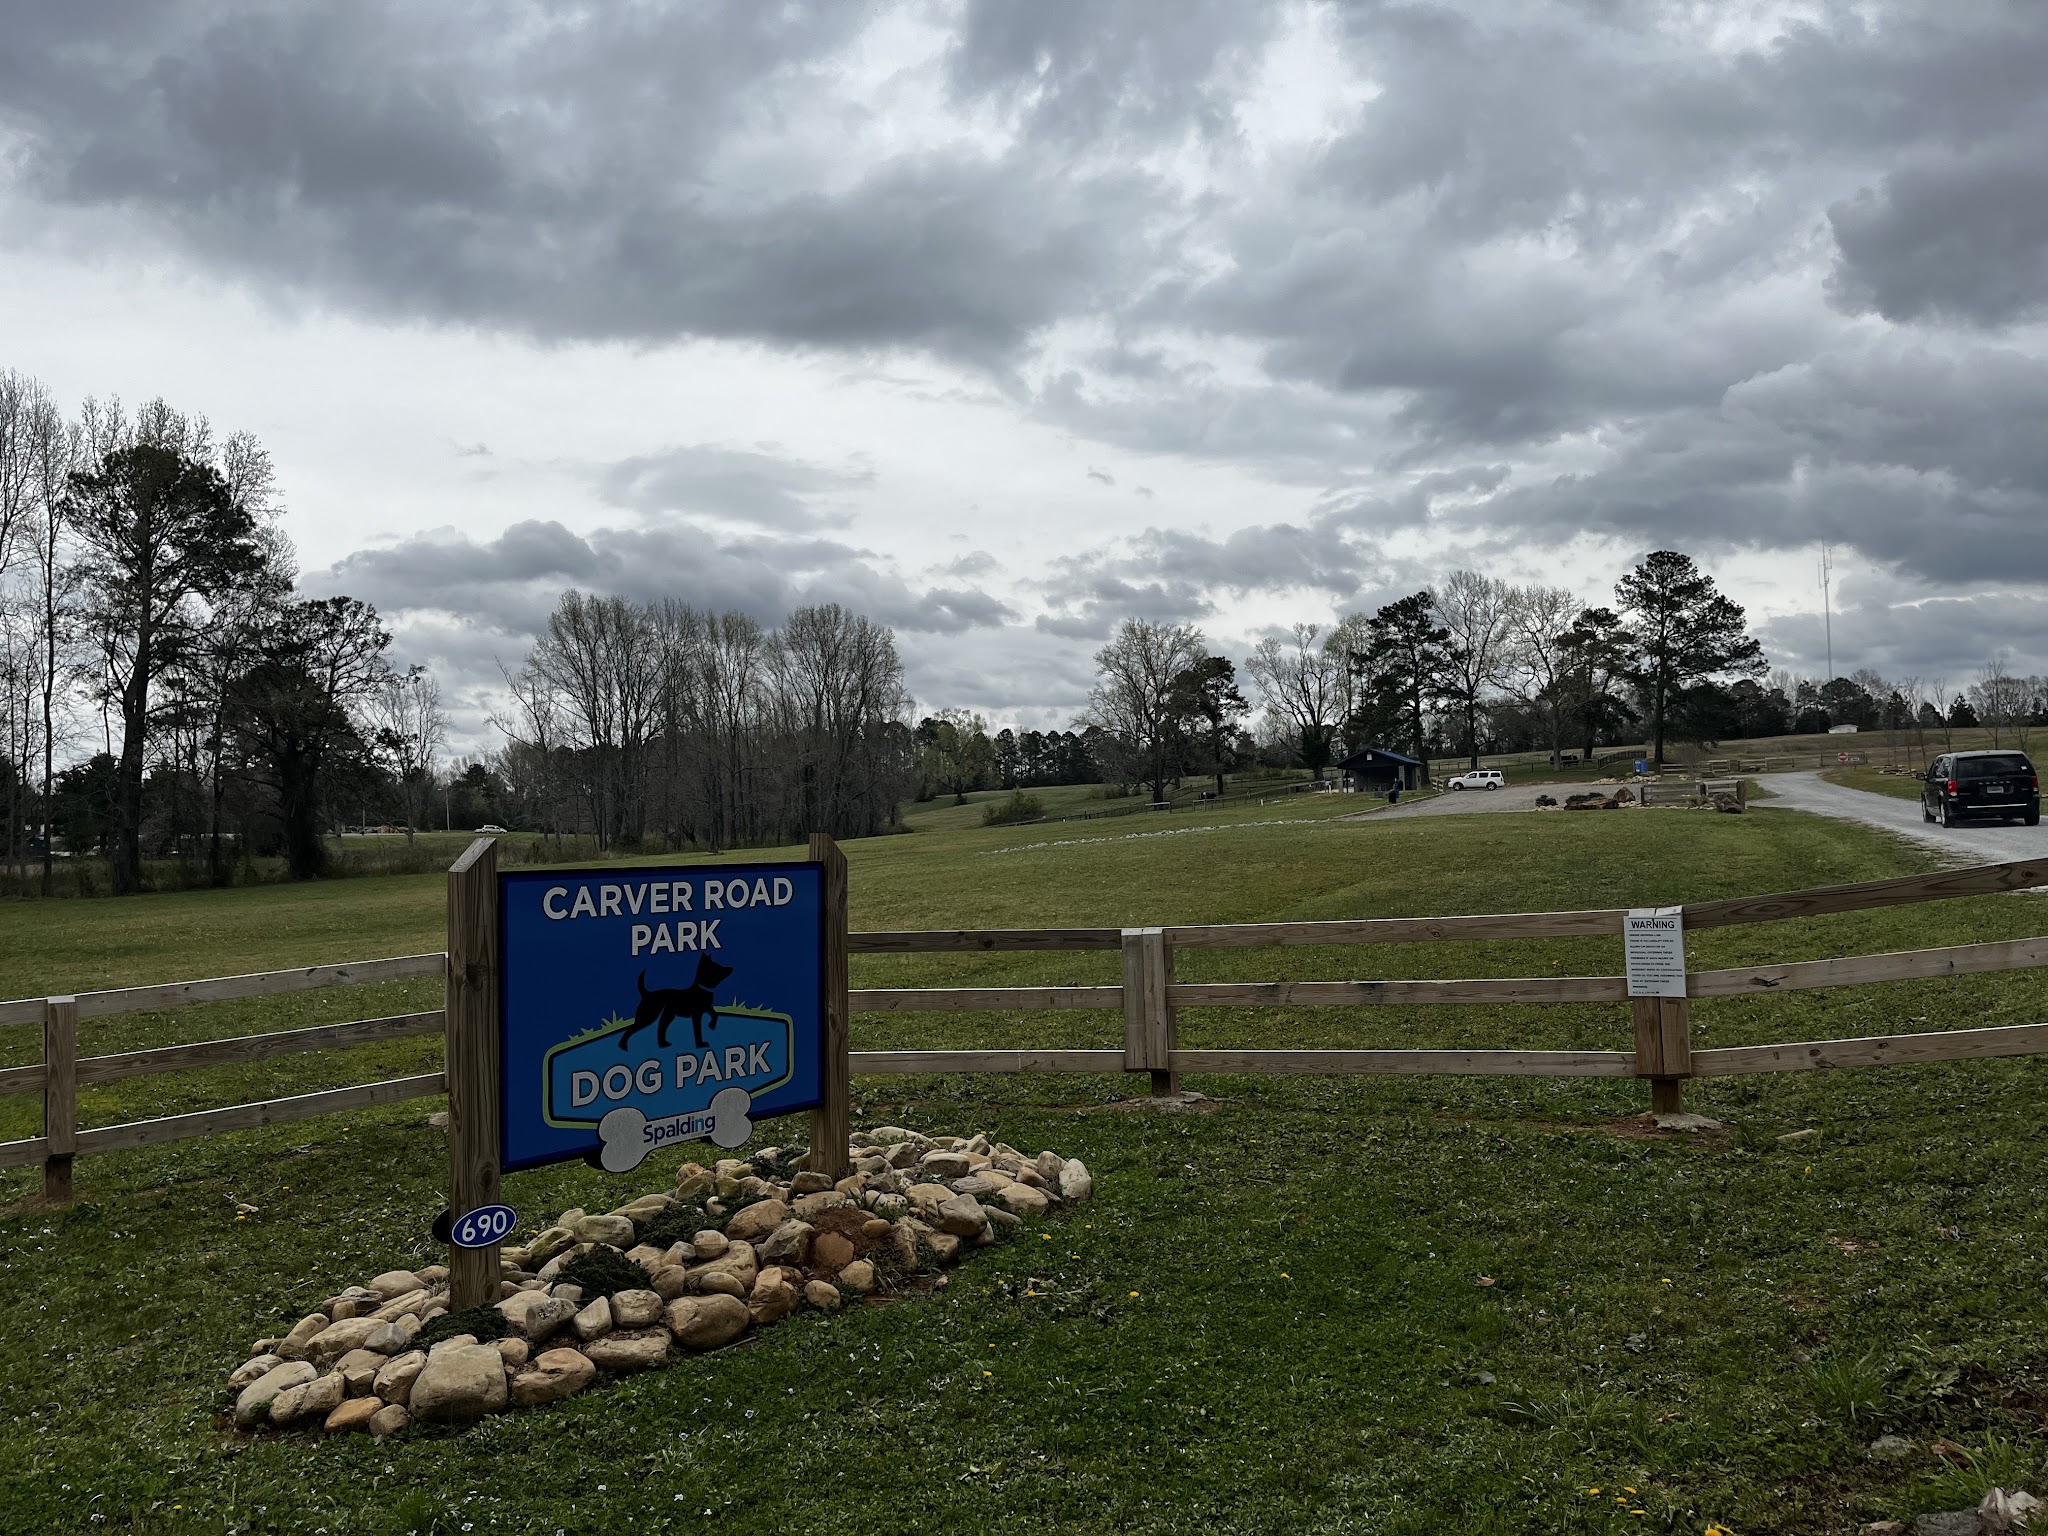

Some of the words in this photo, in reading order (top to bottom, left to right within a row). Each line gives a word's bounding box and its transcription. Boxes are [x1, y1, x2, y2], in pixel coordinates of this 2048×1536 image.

[542, 881, 693, 920] CARVER
[704, 877, 793, 910] ROAD
[631, 919, 722, 956] PARK
[1631, 920, 1675, 929] WARNING
[571, 1060, 662, 1107] DOG
[676, 1042, 771, 1088] PARK
[642, 1114, 716, 1145] Spalding
[461, 1210, 507, 1242] 690
